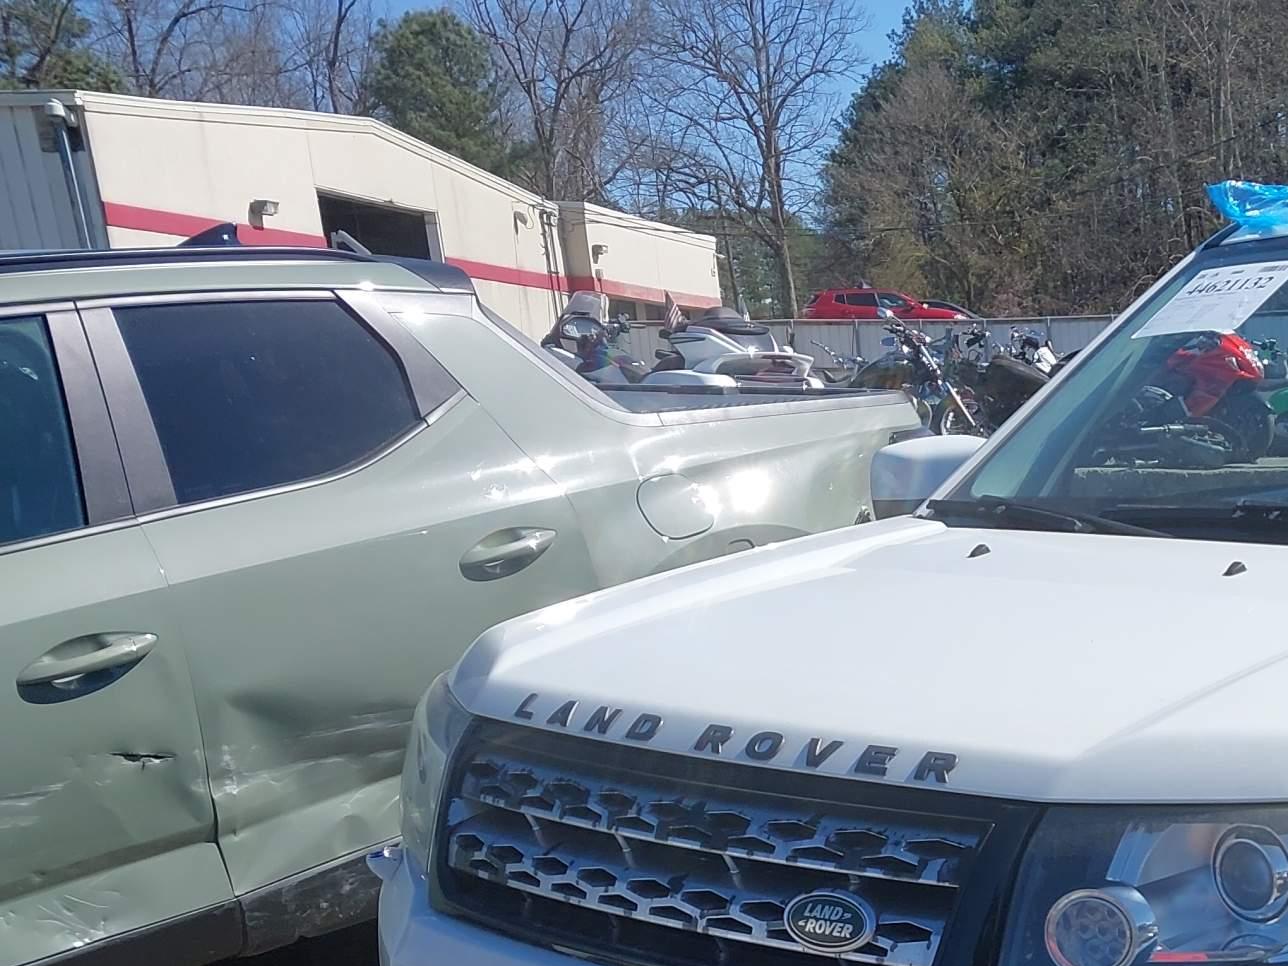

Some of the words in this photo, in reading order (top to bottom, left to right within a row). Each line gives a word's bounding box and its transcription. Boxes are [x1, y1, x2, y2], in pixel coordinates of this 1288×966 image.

[1186, 276, 1275, 296] 44621132
[514, 692, 664, 742] LAND
[693, 723, 960, 785] ROVER
[803, 903, 844, 921] LAND
[804, 918, 854, 939] ROVER
